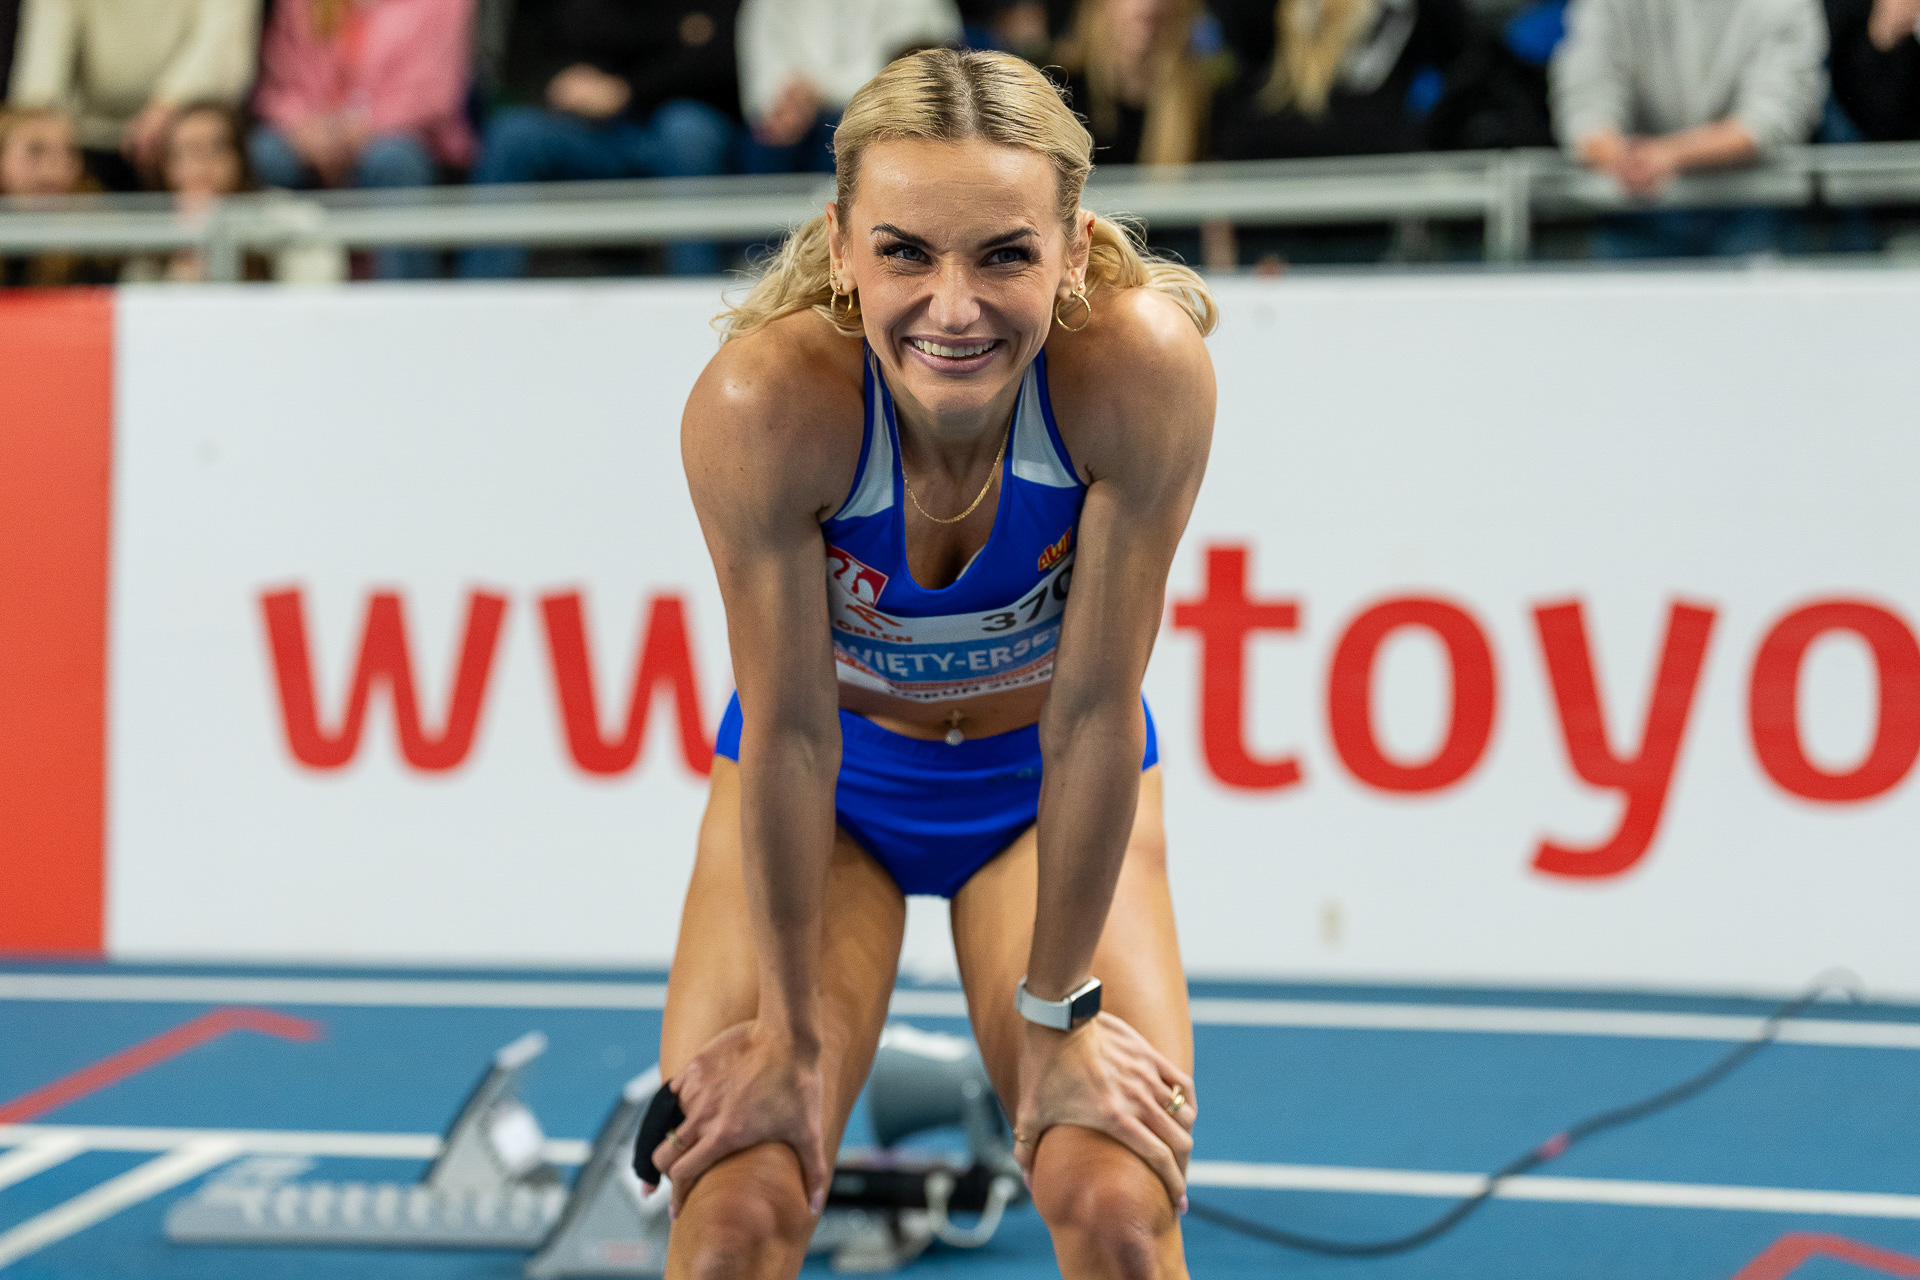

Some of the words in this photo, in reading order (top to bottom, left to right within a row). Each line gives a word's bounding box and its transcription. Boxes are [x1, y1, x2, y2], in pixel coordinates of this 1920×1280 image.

[981, 565, 1074, 632] 370
[832, 625, 1061, 677] WIĘTY-ERSE
[836, 619, 913, 643] ORLEN
[1170, 543, 1920, 879] toyo
